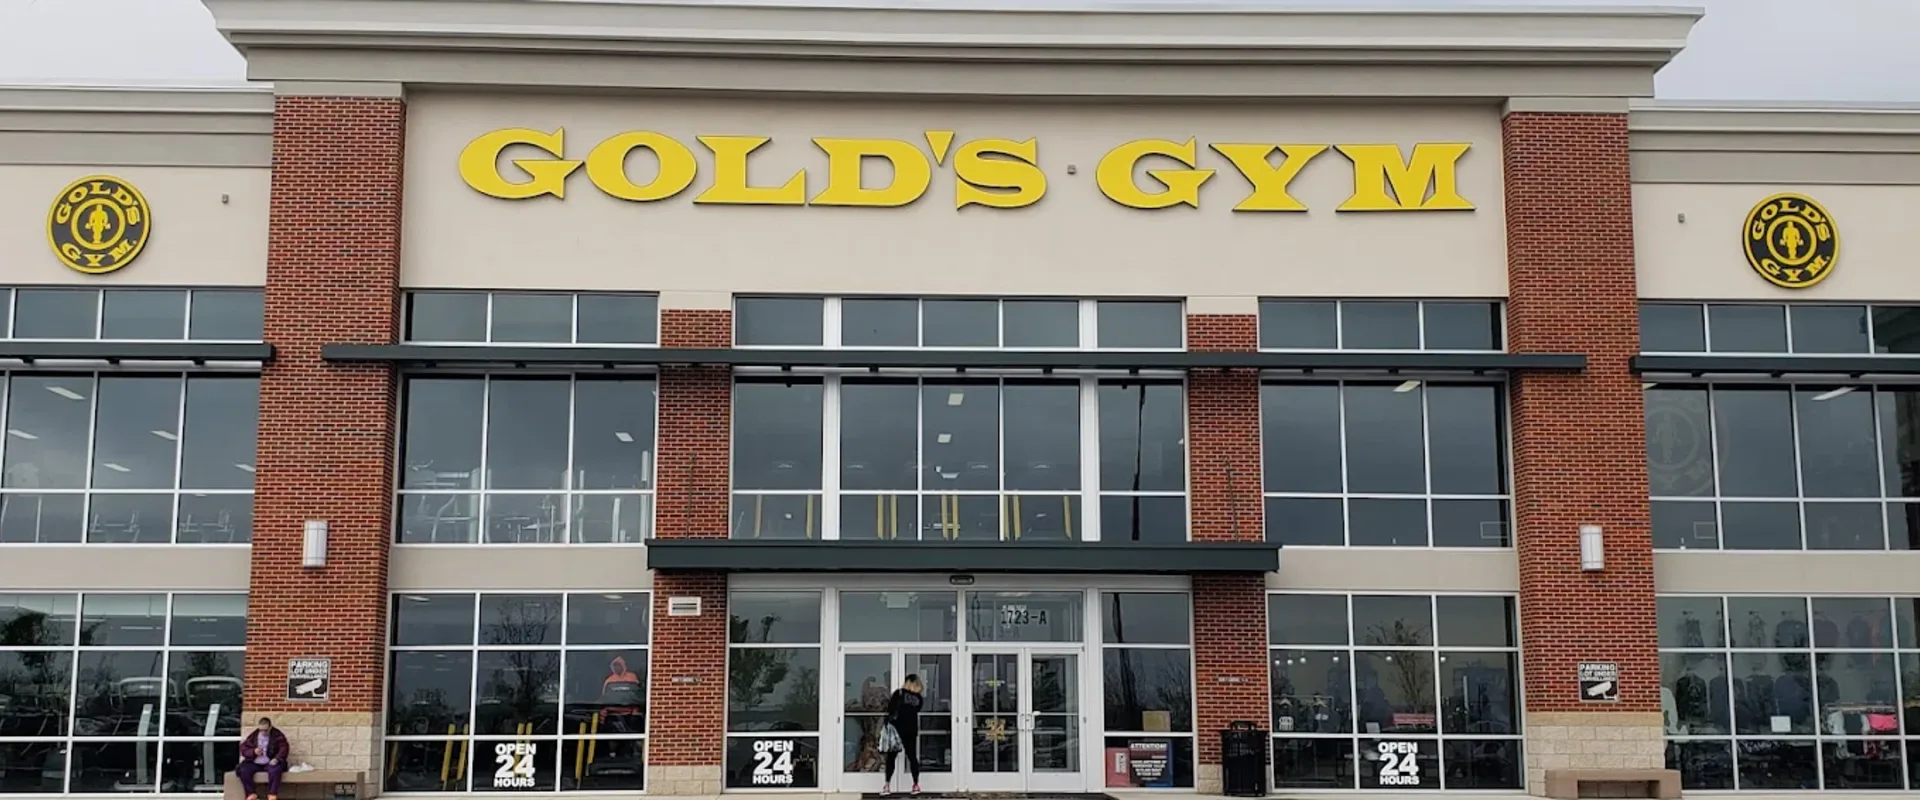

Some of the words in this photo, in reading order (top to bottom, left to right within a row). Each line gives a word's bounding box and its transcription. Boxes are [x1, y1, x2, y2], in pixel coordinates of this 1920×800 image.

[458, 126, 1047, 210] GOLD'S
[1095, 136, 1477, 212] GYM
[56, 182, 140, 225] GOLD'S
[1752, 200, 1831, 241] GOLD'S
[1001, 609, 1047, 625] 1723-A
[494, 743, 537, 756] OPEN
[754, 740, 794, 752] OPEN
[1378, 741, 1418, 754] OPEN
[495, 755, 536, 777] 24
[753, 751, 793, 774] 24
[1380, 753, 1419, 775] 24
[493, 777, 536, 788] HOURS
[752, 774, 794, 784] HOURS
[1380, 775, 1420, 785] HOURS
